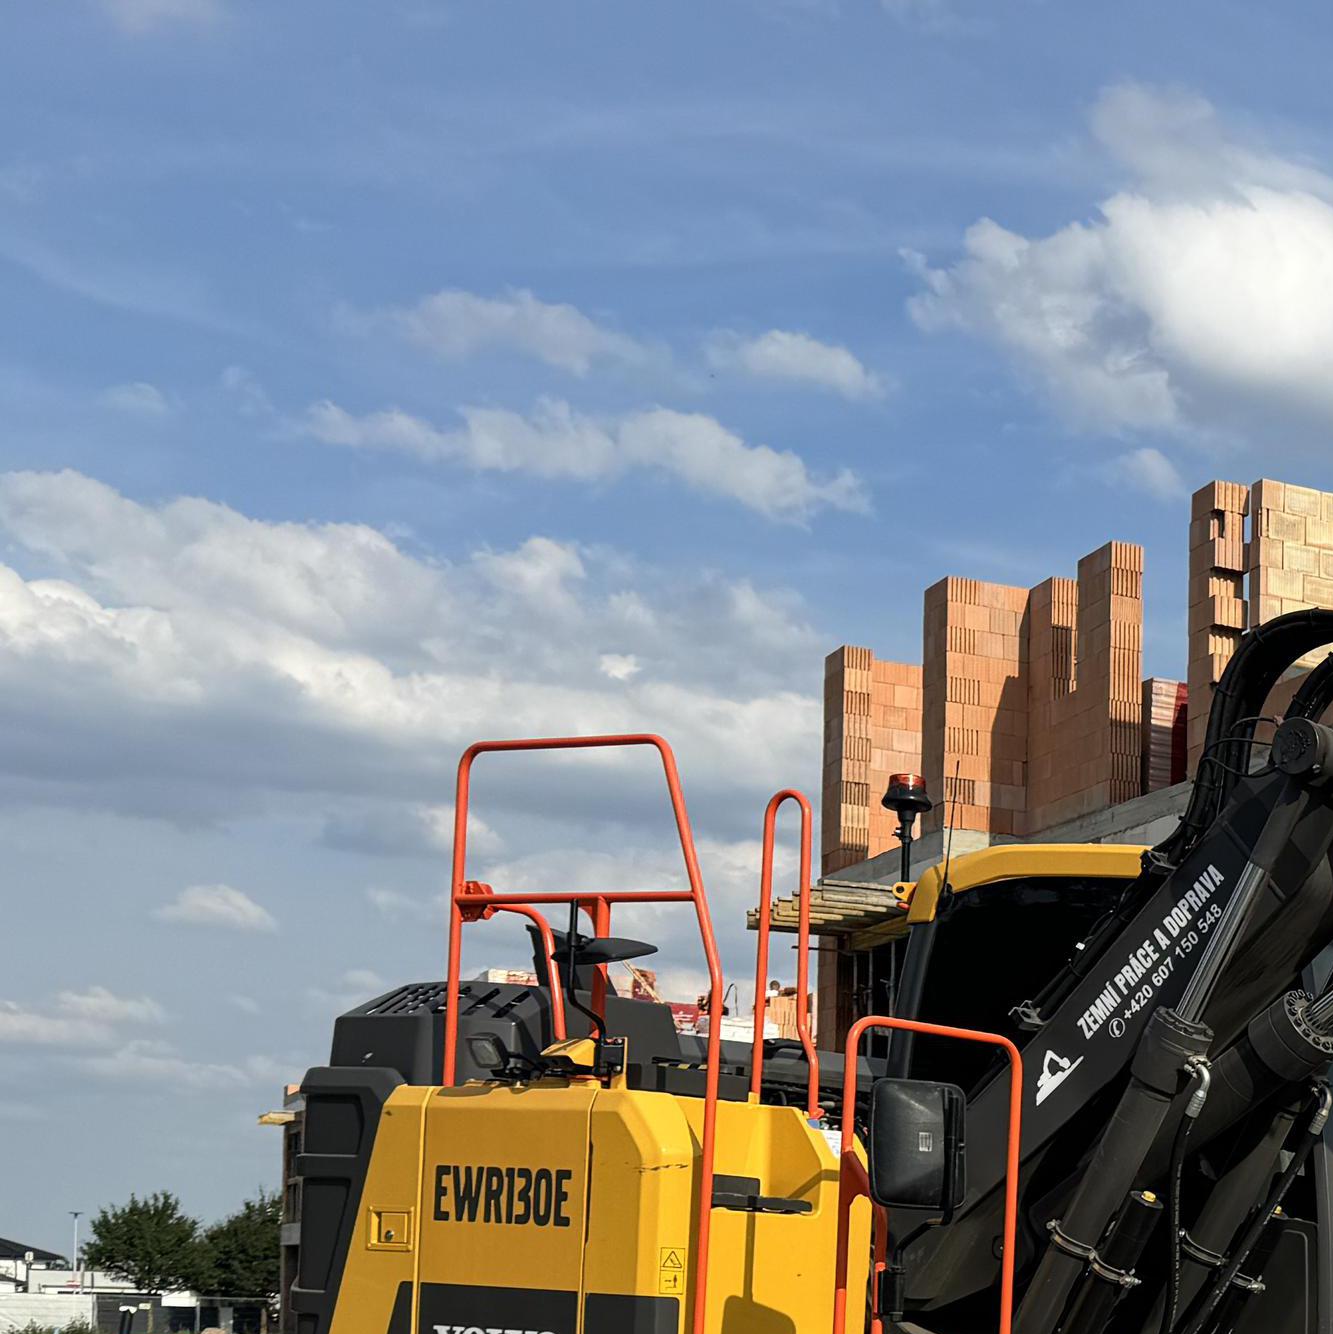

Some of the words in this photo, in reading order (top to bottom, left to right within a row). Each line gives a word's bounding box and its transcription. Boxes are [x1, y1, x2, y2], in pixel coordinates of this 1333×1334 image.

[1076, 981, 1122, 1040] ZEMNÍ
[1114, 939, 1160, 995] PRÁCE
[1153, 928, 1171, 950] A
[1162, 864, 1225, 938] DOPRAVA
[1124, 984, 1154, 1019] +420
[1151, 956, 1175, 987] 607
[1175, 931, 1199, 959] 150
[1197, 903, 1222, 933] 548
[432, 1164, 572, 1228] EWR130E
